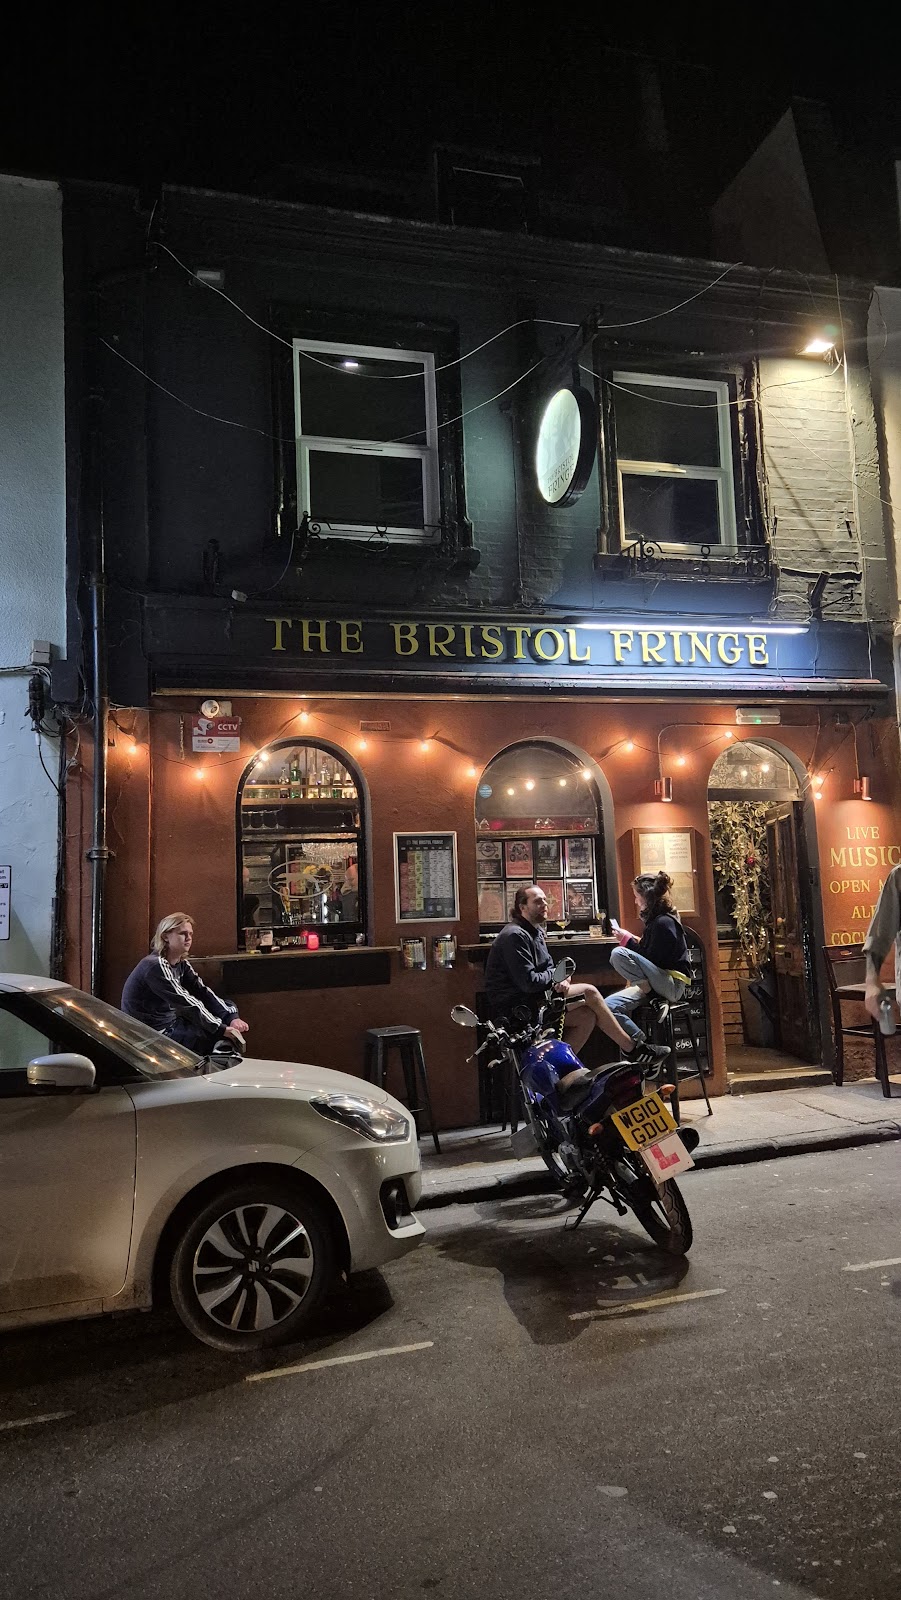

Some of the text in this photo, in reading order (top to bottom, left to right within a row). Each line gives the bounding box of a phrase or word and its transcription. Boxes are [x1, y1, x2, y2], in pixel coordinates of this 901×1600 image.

[548, 463, 574, 496] FRINGE
[265, 617, 770, 665] THE BRISTOL FRINGE
[846, 827, 880, 839] LIVE
[830, 846, 901, 867] MUSIC
[829, 880, 870, 893] OPEN
[618, 1097, 661, 1129] WG10
[631, 1115, 669, 1145] GDU
[649, 1143, 681, 1170] L
